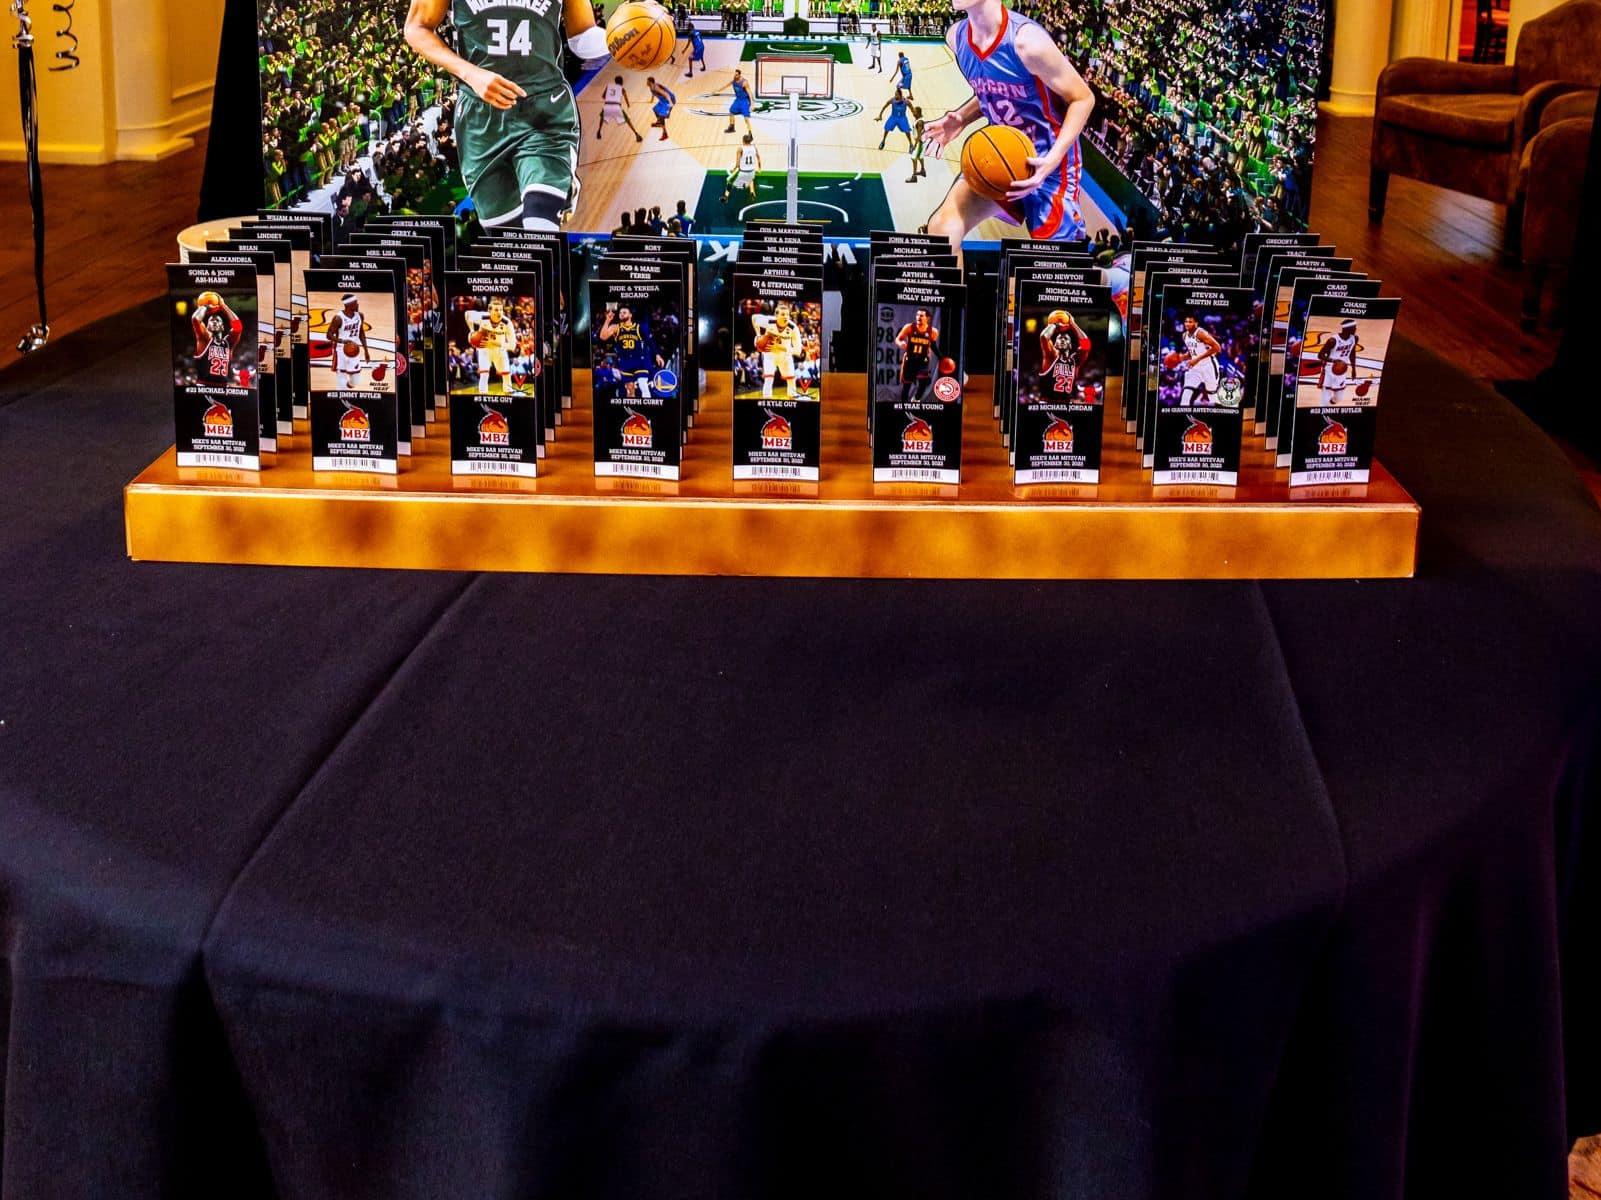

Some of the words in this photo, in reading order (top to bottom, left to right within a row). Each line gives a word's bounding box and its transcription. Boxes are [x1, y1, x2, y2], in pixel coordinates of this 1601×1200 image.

[487, 19, 532, 56] 34
[767, 281, 803, 289] STEPHANIE
[623, 340, 635, 349] 30
[913, 345, 922, 353] 11
[210, 360, 229, 376] 23
[1054, 376, 1073, 393] 23
[207, 425, 231, 434] MBZ
[344, 430, 368, 438] MBZ
[482, 434, 507, 442] MBZ
[625, 436, 649, 445] MBZ
[765, 438, 789, 447] MBZ
[906, 442, 930, 450] MBZ
[1046, 442, 1071, 450] MBZ
[1185, 444, 1209, 452] MBZ
[1321, 444, 1345, 452] MBZ
